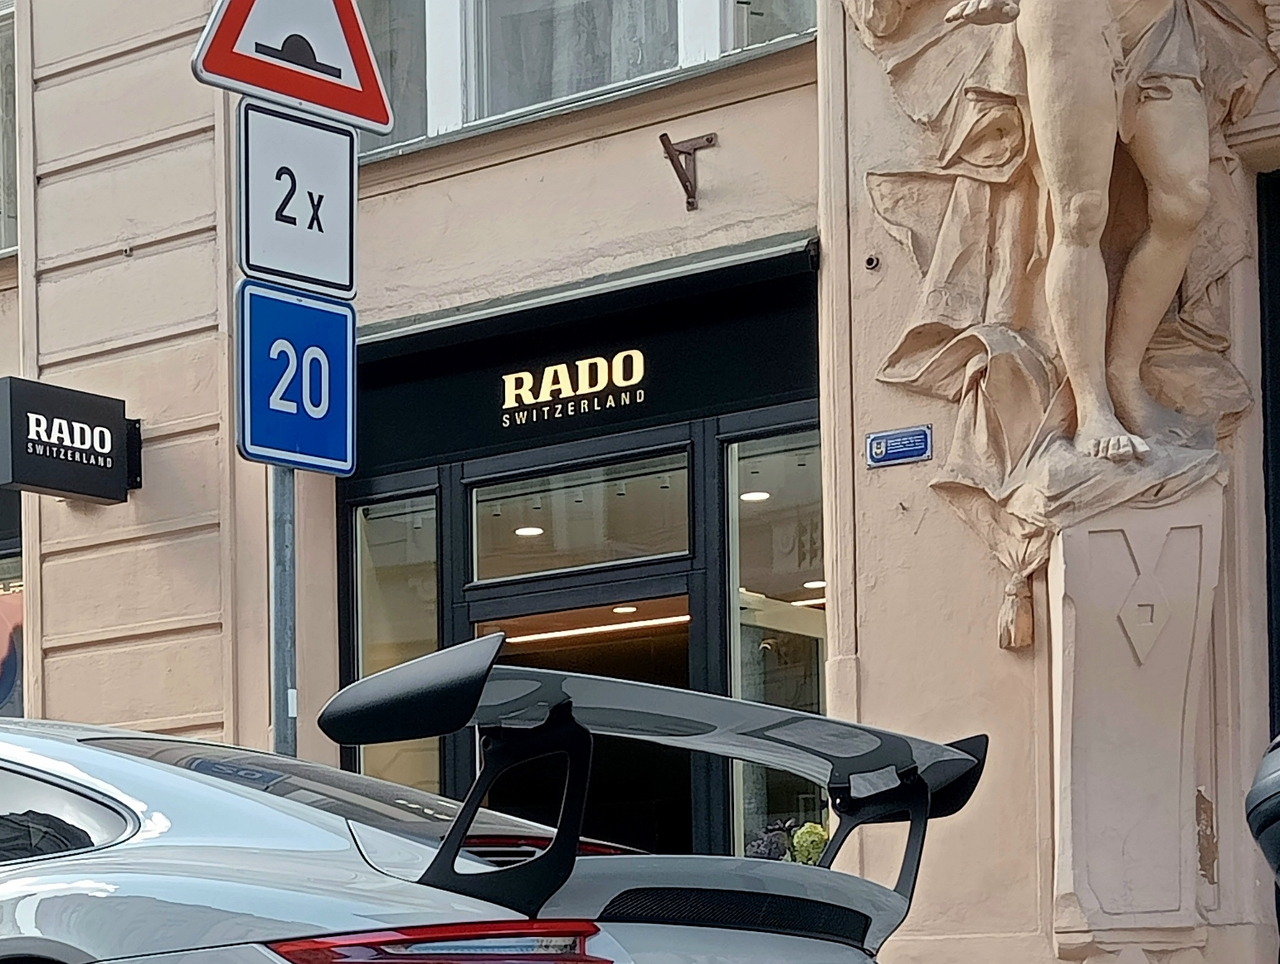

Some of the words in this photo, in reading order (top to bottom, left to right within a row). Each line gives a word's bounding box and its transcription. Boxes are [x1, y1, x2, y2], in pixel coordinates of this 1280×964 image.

[269, 339, 330, 419] 20
[501, 349, 645, 410] RADO
[502, 389, 645, 428] SWITZERLAND
[26, 412, 112, 454] RADO
[27, 442, 113, 468] SWITZERLAND
